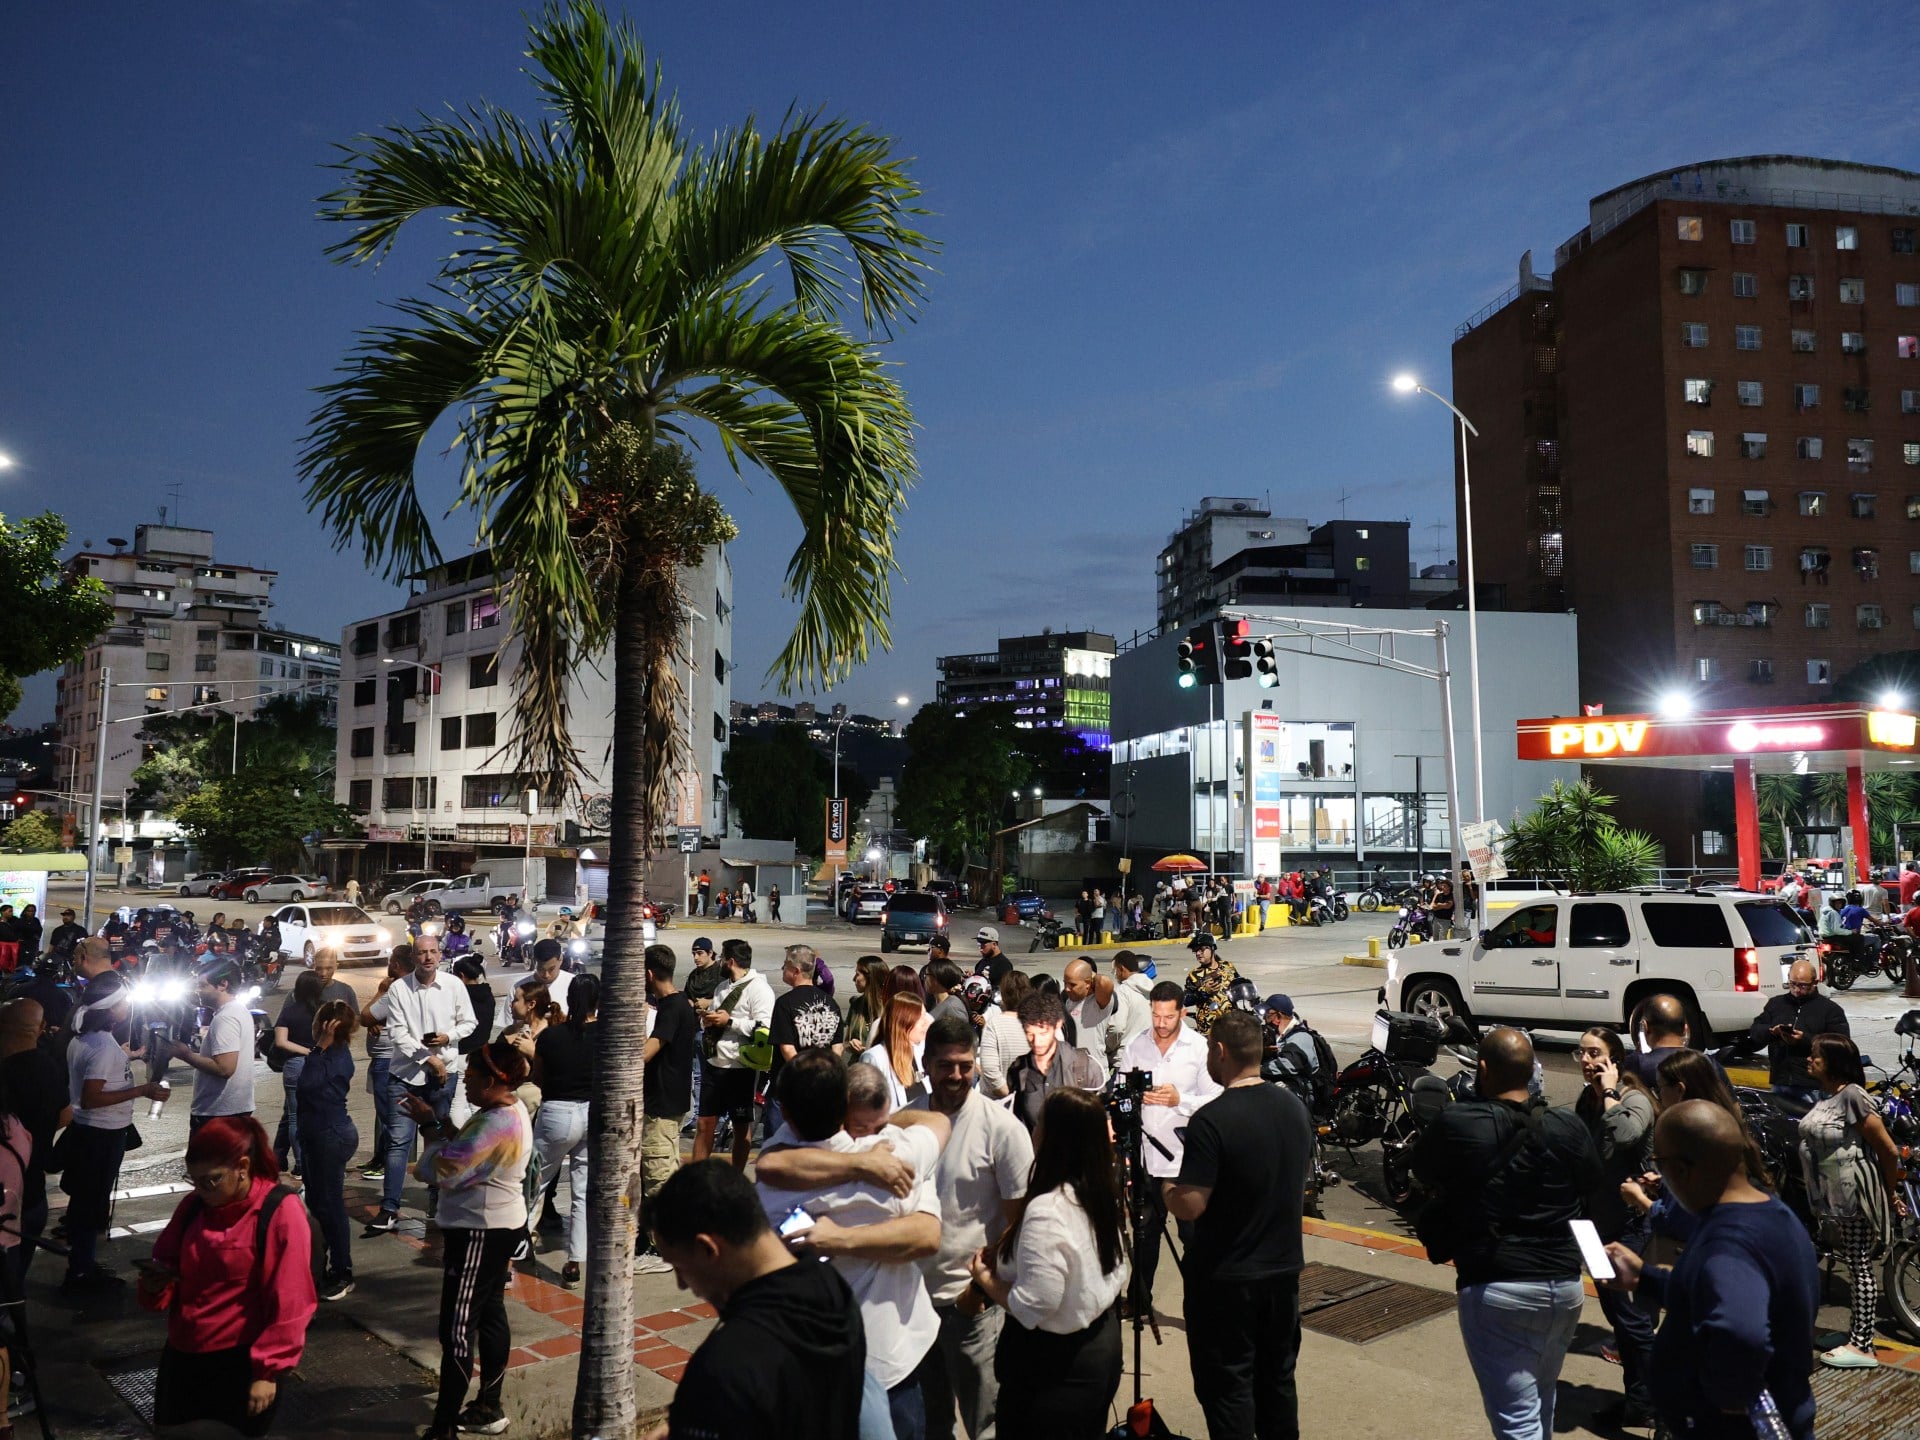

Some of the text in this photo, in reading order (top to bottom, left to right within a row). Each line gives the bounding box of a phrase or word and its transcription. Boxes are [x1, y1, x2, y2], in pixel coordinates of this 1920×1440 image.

[1549, 721, 1648, 755] PDV
[831, 802, 840, 839] PÁRYMO
[1235, 882, 1254, 890] SALIDA
